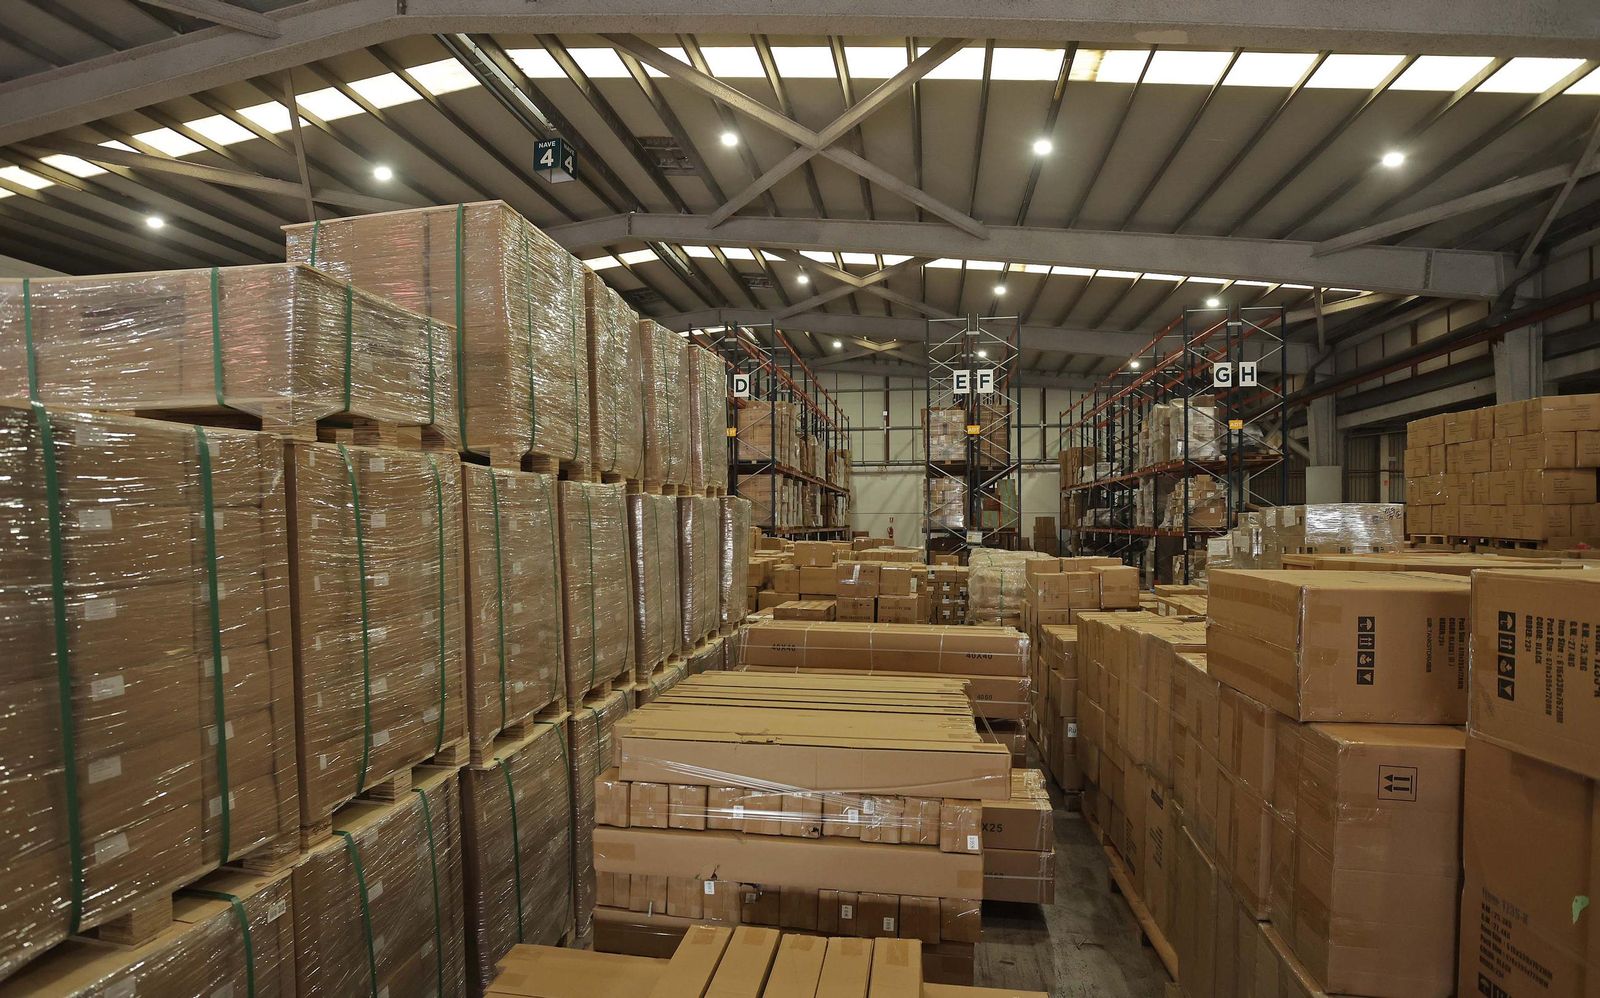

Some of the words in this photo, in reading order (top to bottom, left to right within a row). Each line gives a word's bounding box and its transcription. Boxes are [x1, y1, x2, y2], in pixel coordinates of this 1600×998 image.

[538, 140, 556, 149] NAVE
[540, 148, 554, 167] 4
[564, 155, 574, 174] 4
[957, 375, 967, 389] E
[980, 374, 990, 388] F
[1215, 366, 1230, 383] G
[1241, 366, 1255, 382] H
[735, 378, 748, 393] D
[1546, 618, 1554, 635] Pack
[1557, 619, 1566, 637] Item
[1546, 637, 1554, 652] Size
[1557, 638, 1565, 653] Size
